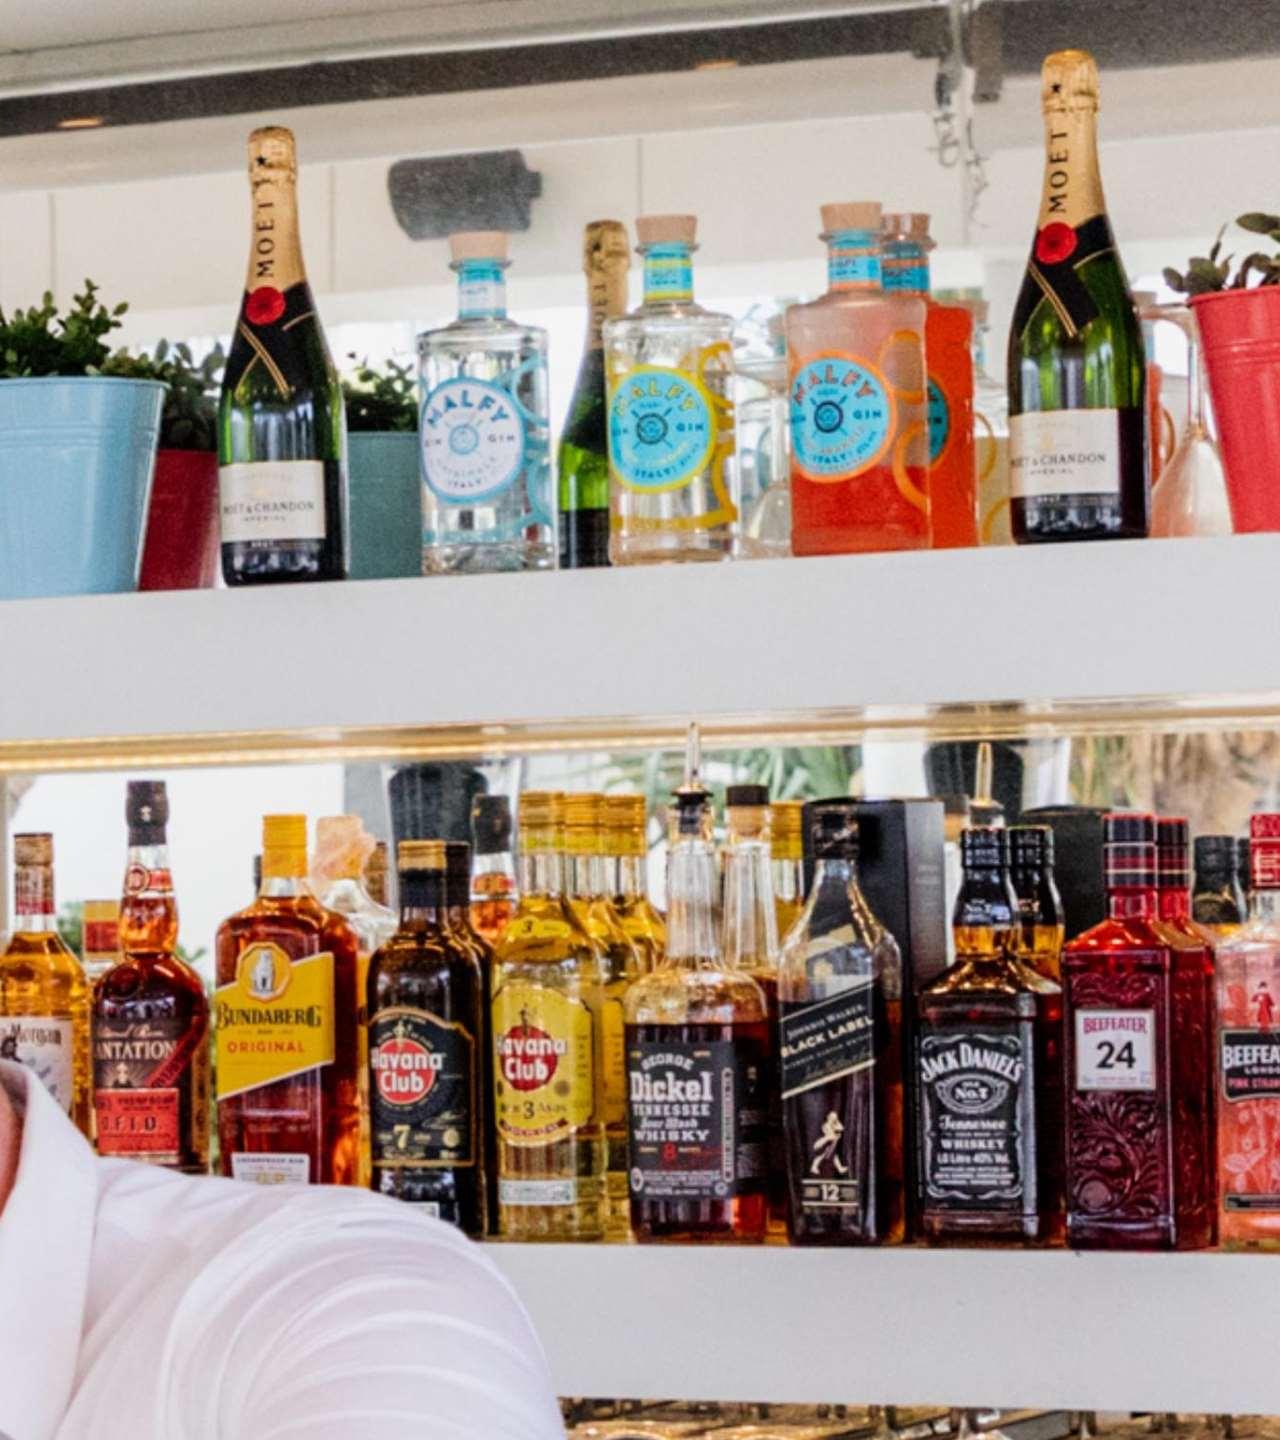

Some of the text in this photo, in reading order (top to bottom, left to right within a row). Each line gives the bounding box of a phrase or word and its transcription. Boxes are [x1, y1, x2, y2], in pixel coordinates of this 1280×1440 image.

[427, 389, 510, 429] MALFY
[1040, 452, 1107, 465] CHANDON
[254, 500, 316, 513] CHANDON
[215, 1002, 322, 1031] BUNDABERG
[1082, 1015, 1148, 1035] BEEFEATER
[780, 1014, 875, 1059] BLACK LABEL
[226, 1039, 306, 1055] ORIGINAL
[1096, 1039, 1137, 1070] 24
[504, 1057, 549, 1082] Club
[640, 1052, 695, 1072] GEORGE
[920, 1042, 1025, 1084] JACK DANIEL'S
[380, 1070, 425, 1094] Club
[629, 1070, 715, 1103] Dickel
[523, 1101, 536, 1120] 3
[632, 1103, 711, 1117] TENNESSEE
[939, 1114, 1007, 1131] Tennessee
[393, 1124, 411, 1150] 7
[633, 1129, 710, 1142] WHISKY
[940, 1138, 1006, 1150] WHISKEY
[663, 1141, 678, 1161] 8
[820, 1184, 841, 1201] 12
